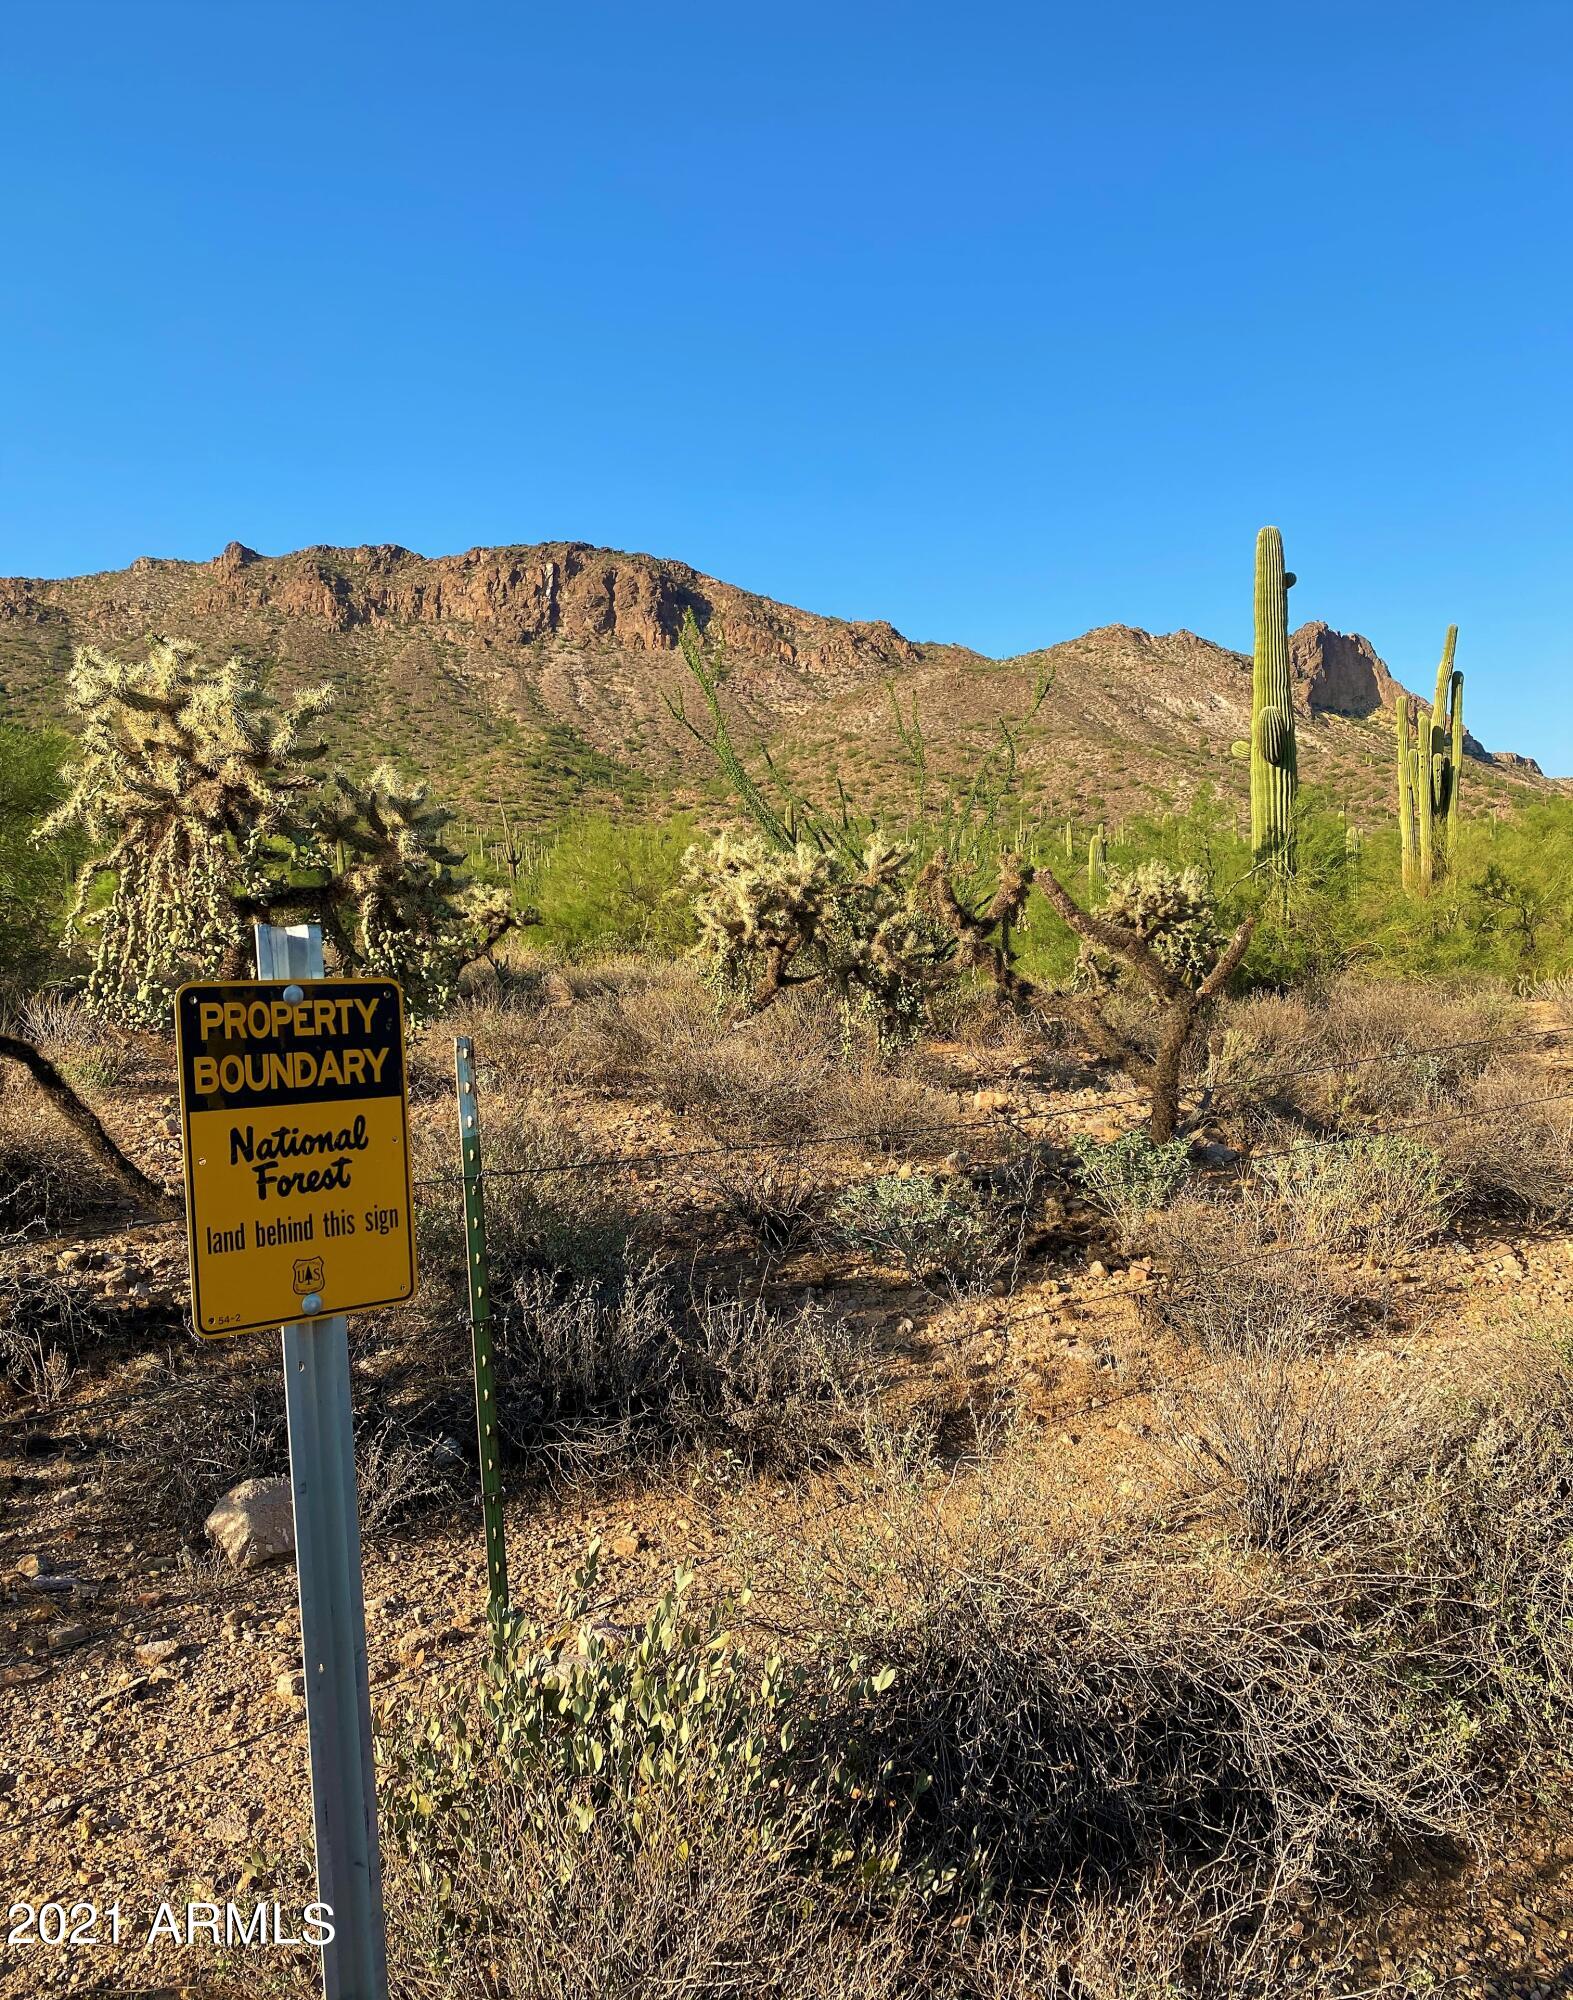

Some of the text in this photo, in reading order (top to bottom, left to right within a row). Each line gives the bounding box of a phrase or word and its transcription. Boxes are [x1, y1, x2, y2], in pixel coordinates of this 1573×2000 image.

[199, 998, 379, 1041] PROPERTY
[193, 1047, 389, 1095] BOUNDARY
[229, 1114, 369, 1166] National
[251, 1156, 352, 1201] Forest
[206, 1205, 399, 1255] land behind this sign
[218, 1313, 241, 1325] 54-2
